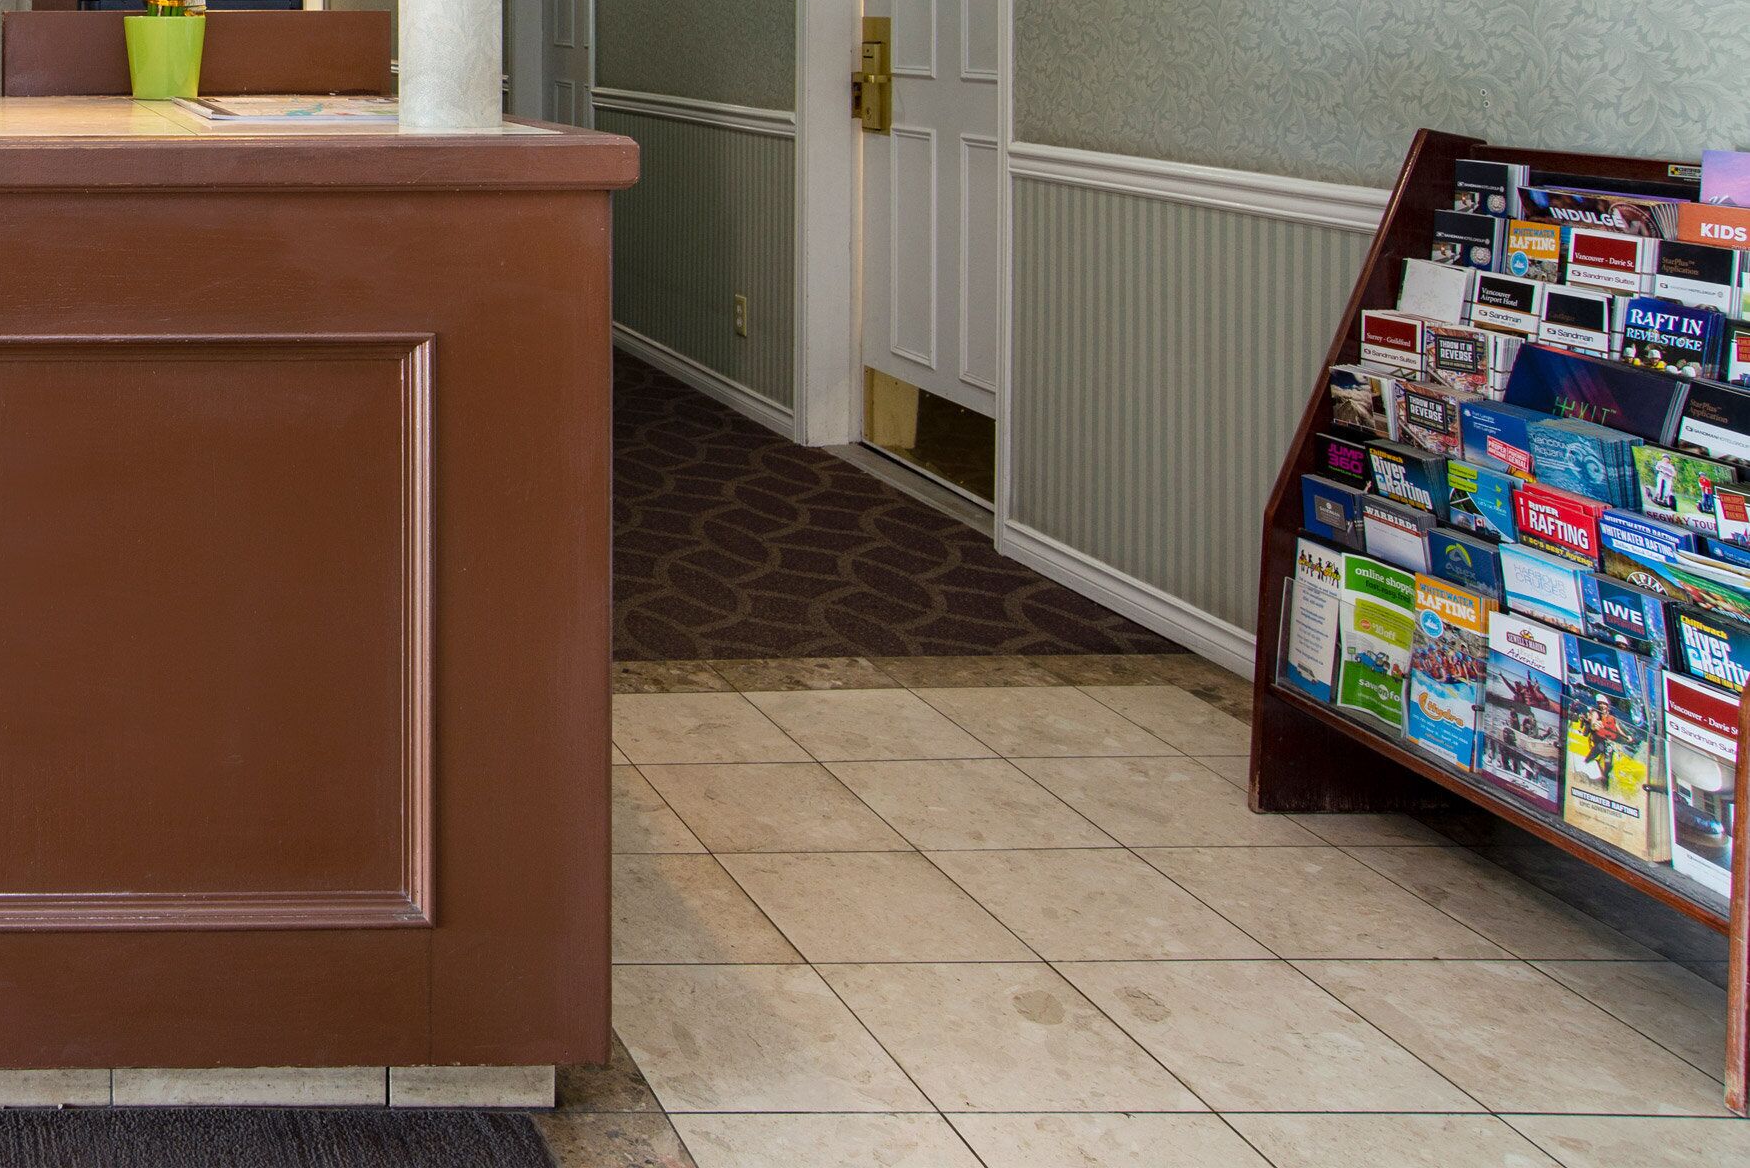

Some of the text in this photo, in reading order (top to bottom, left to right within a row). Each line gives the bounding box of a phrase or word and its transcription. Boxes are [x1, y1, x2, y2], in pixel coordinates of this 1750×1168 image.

[1550, 207, 1626, 229] INDULGE
[1700, 222, 1748, 242] KIDS
[1510, 235, 1556, 251] RAFTING
[1575, 252, 1604, 264] Vancouver
[1608, 256, 1625, 267] Davie
[1581, 270, 1635, 286] Sandman Suites
[1661, 264, 1700, 276] Application
[1480, 294, 1519, 307] Airport Hotel
[1481, 286, 1511, 299] Vancouver
[1488, 310, 1522, 324] Sandman
[1630, 308, 1704, 336] RAFT IN
[1366, 332, 1383, 343] Surrey
[1386, 336, 1411, 348] Guildford
[1439, 340, 1460, 350] THROW
[1557, 329, 1593, 343] Sandman
[1626, 327, 1703, 352] REVELSTOKE
[1371, 349, 1417, 365] Sandman Suites
[1440, 348, 1473, 363] REVERSE
[1408, 395, 1428, 408] THROW
[1410, 405, 1444, 424] REVERSE
[1690, 407, 1729, 424] Application
[1328, 443, 1365, 460] JUMP
[1370, 448, 1403, 463] Chilliwack
[1328, 453, 1363, 474] 360
[1370, 454, 1405, 480] River
[1376, 474, 1432, 510] Rafting
[1364, 505, 1418, 532] WARBIRDS
[1528, 500, 1559, 518] RIVER
[1529, 508, 1589, 550] RAFTING
[1646, 511, 1689, 528] SEGWAY
[1546, 543, 1565, 556] BEST
[1601, 522, 1645, 549] WHITEWATER
[1645, 537, 1675, 558] RAFTING
[1355, 566, 1384, 583] online
[1514, 563, 1565, 589] HARBOUR
[1419, 583, 1474, 608] WHITEWATER
[1515, 572, 1567, 599] CRUISES
[1416, 589, 1476, 623] RAFTING
[1602, 599, 1644, 626] IWE
[1680, 615, 1728, 640] Chilliwack
[1682, 623, 1731, 661] River
[1507, 648, 1546, 670] Adventure
[1582, 658, 1621, 683] IWE
[1670, 700, 1702, 722] Vancouver
[1708, 717, 1730, 733] Davie
[1680, 725, 1717, 747] Sandman
[1571, 787, 1639, 817] WHITEWATER RAFTING
